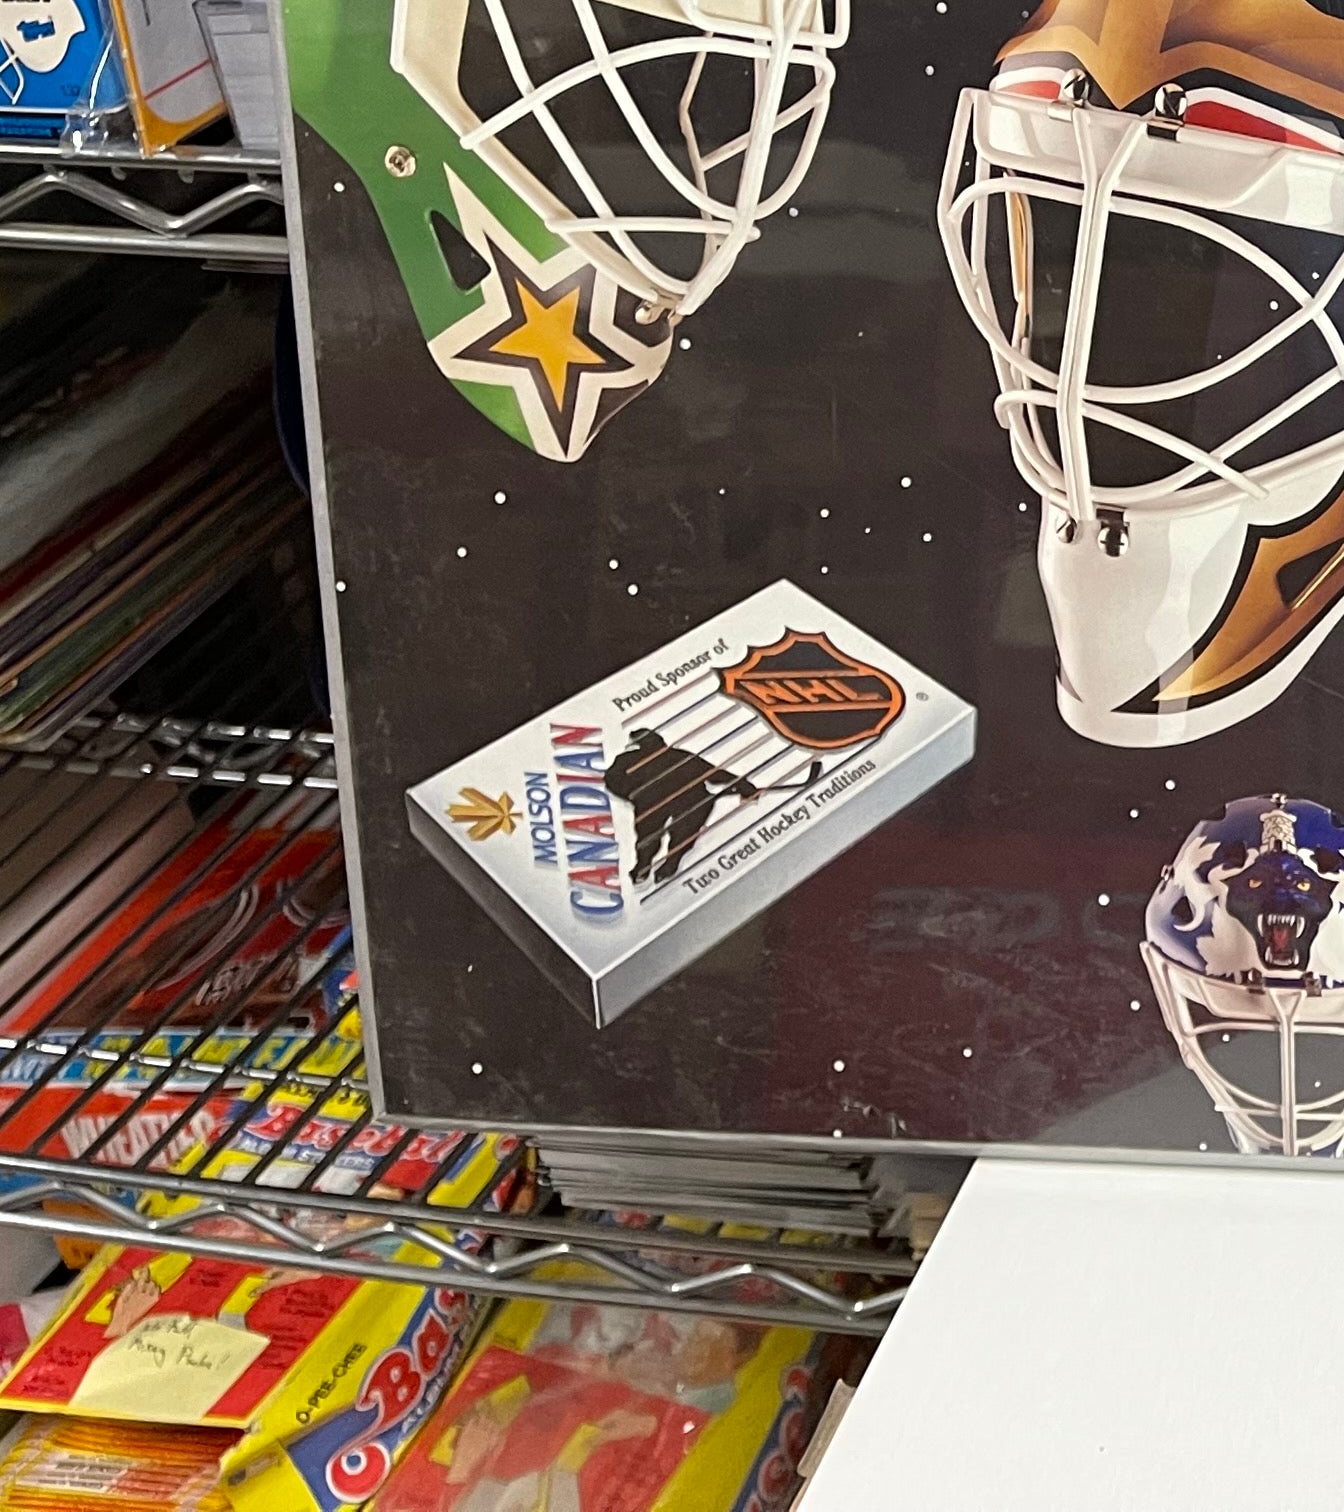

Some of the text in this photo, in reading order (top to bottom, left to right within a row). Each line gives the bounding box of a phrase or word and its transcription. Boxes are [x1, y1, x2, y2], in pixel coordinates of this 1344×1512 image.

[612, 638, 731, 712] Proud Sponsor of
[738, 678, 886, 705] NHL
[523, 771, 558, 865] MOLSON
[549, 722, 625, 916] CANADIAN
[683, 758, 877, 895] Two Great Hockey Traditions
[295, 1343, 368, 1425] O-PEE-CHEE
